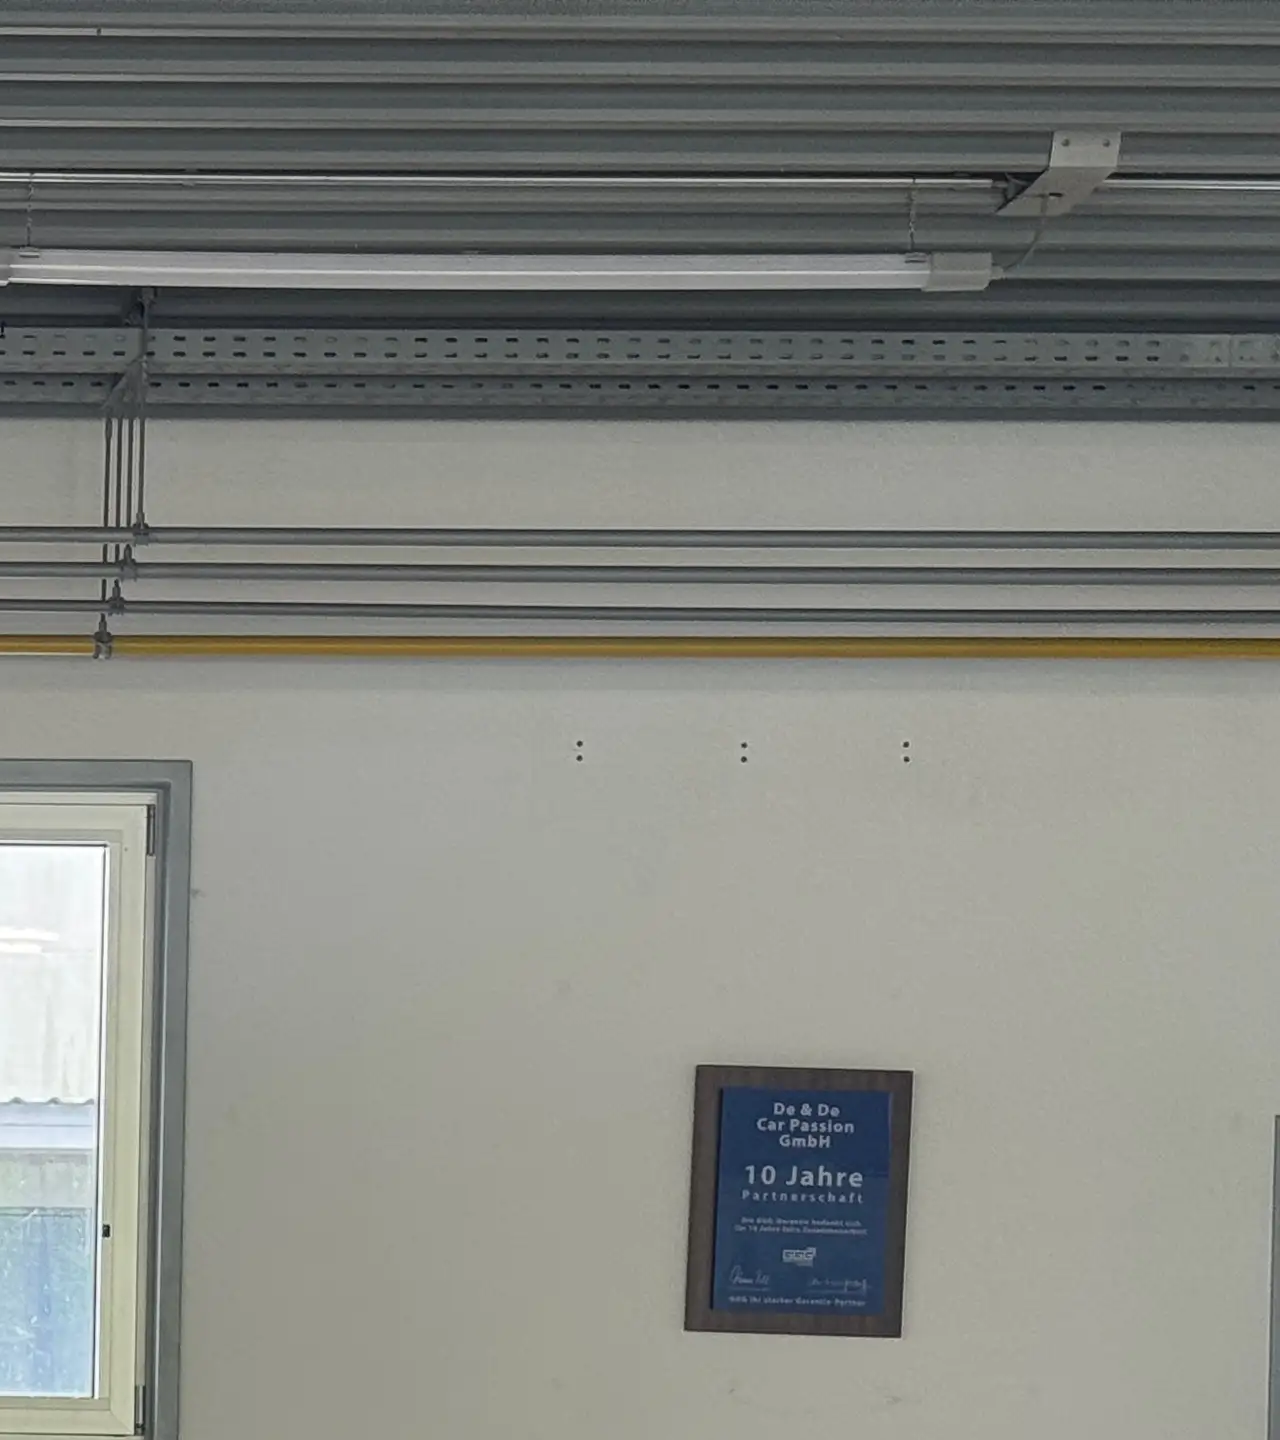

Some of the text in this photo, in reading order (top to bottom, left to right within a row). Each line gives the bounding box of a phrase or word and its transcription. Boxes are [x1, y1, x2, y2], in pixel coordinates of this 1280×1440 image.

[773, 1102, 840, 1117] De & De
[756, 1117, 855, 1133] Car Passion
[779, 1134, 831, 1148] GmbH
[744, 1165, 864, 1187] 10 Jahre
[741, 1189, 864, 1204] Partnerschaft
